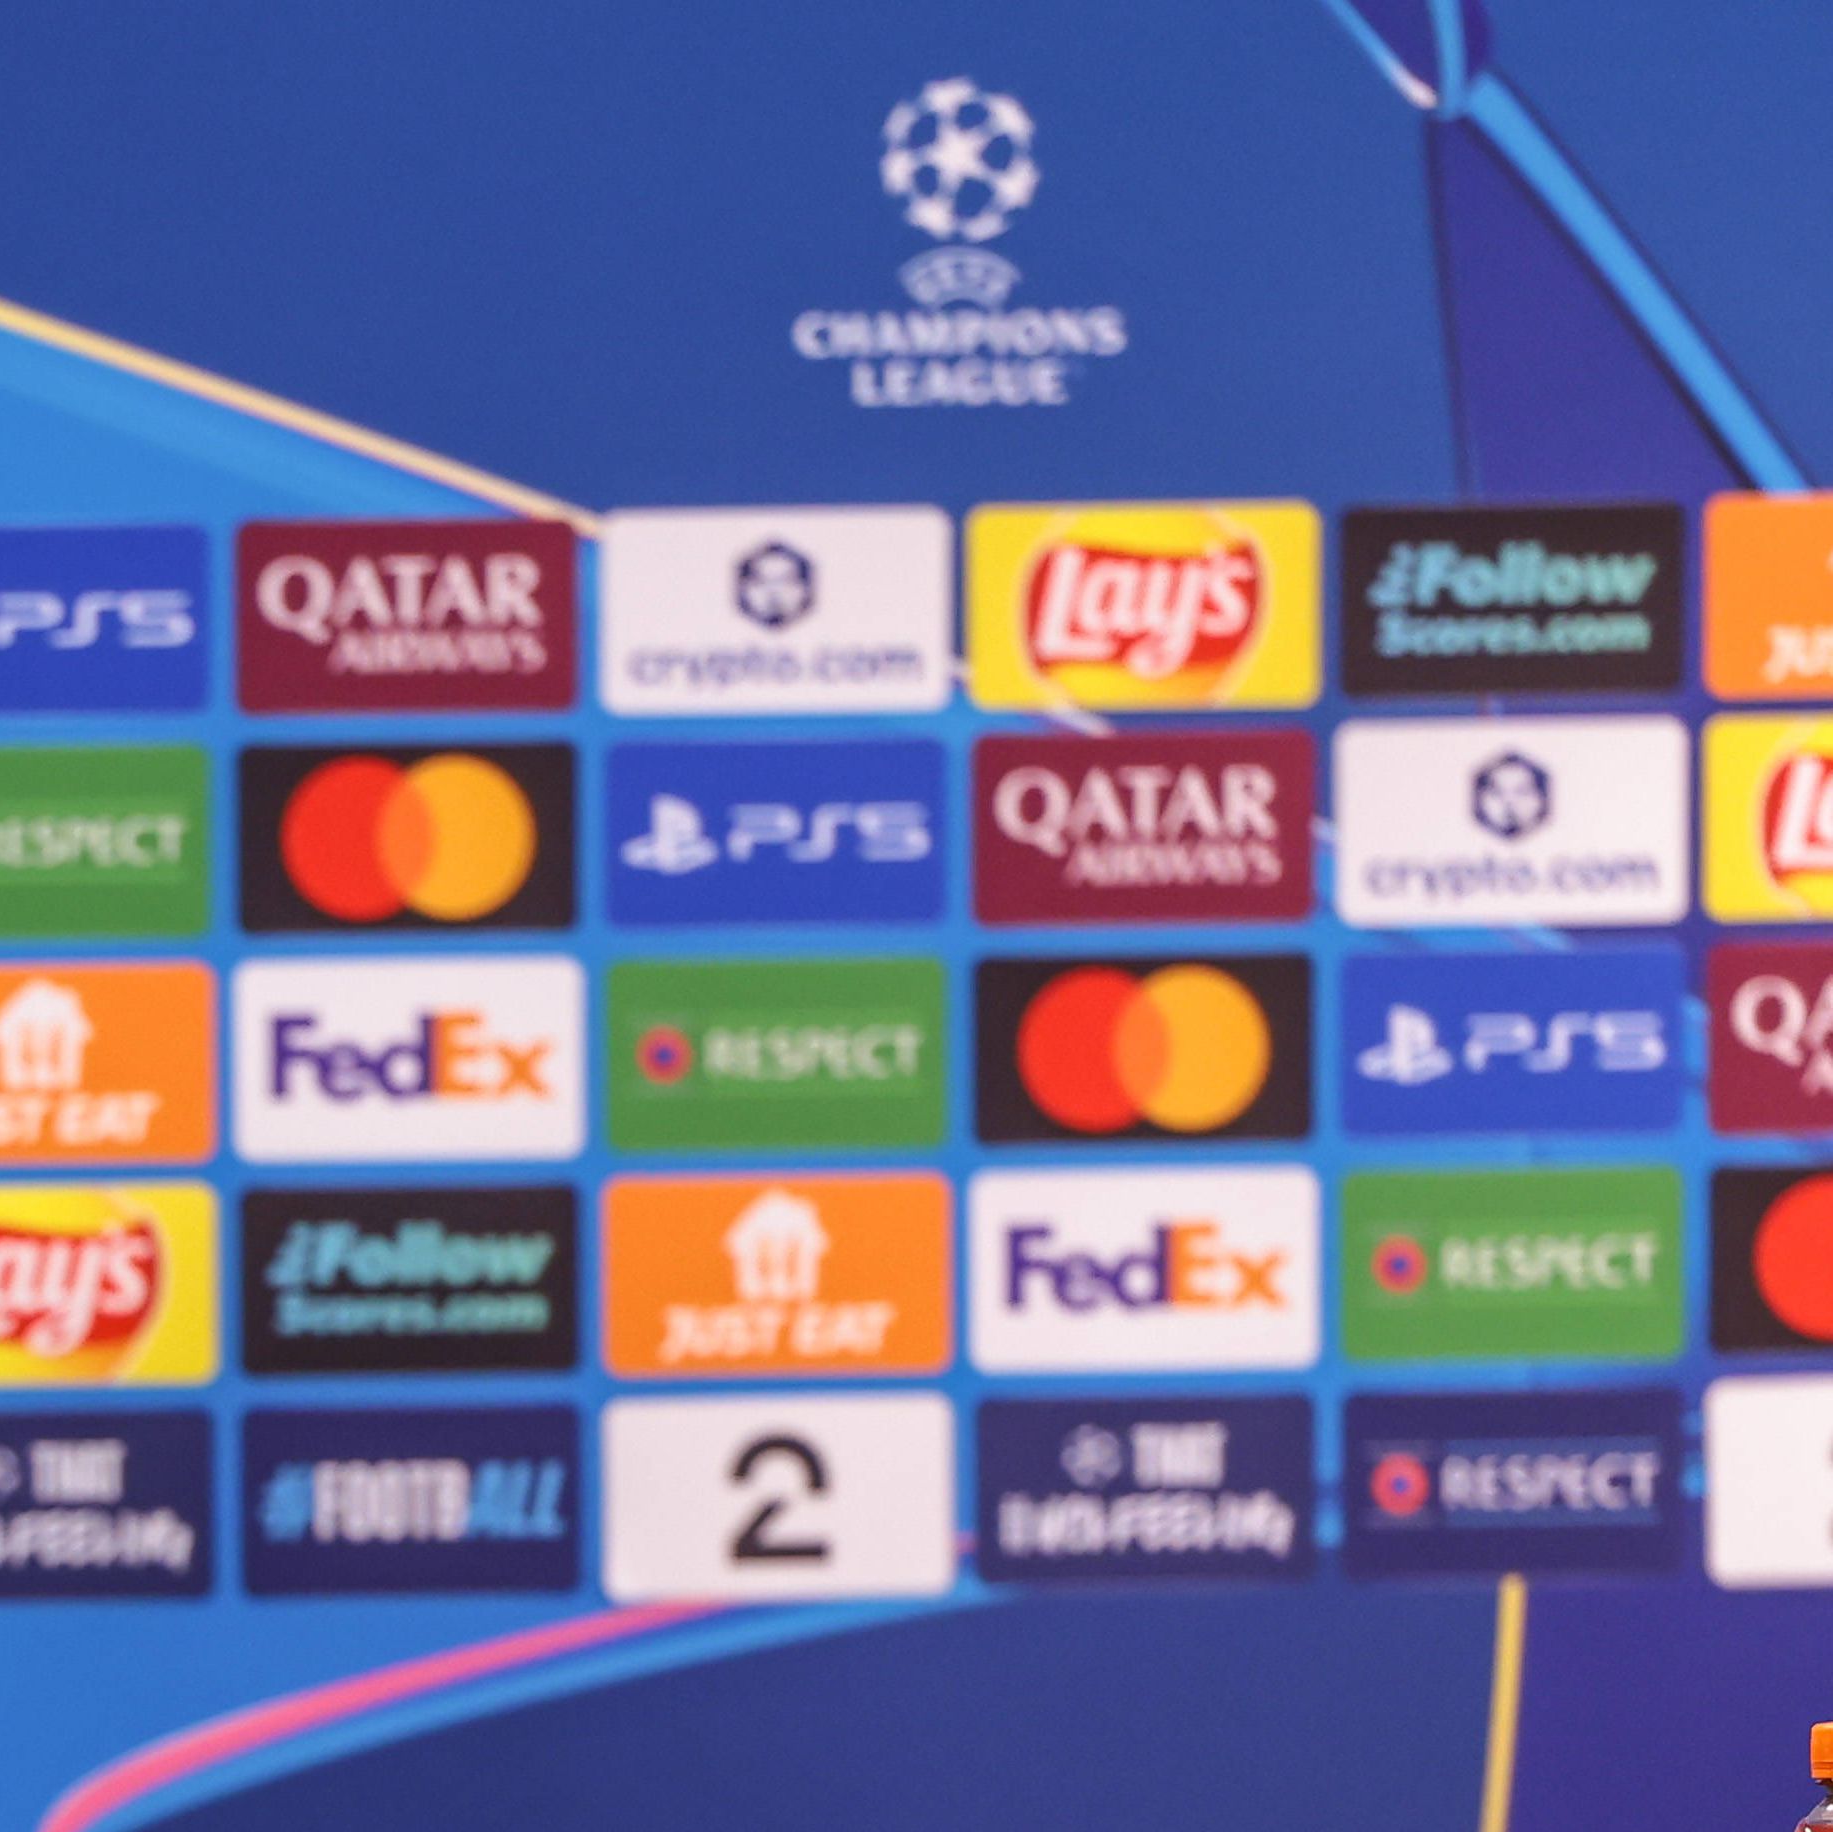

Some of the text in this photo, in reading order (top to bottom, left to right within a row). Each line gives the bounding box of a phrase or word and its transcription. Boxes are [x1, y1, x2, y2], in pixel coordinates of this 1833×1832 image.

[257, 554, 545, 644] QATAR
[1033, 543, 1252, 680] Lay's
[727, 803, 932, 862] PS5
[993, 764, 1280, 855] QATAR
[269, 1012, 552, 1102] FedEx
[1464, 1013, 1666, 1072] PS5
[54, 1092, 162, 1145] EAT
[1005, 1222, 1288, 1314] FedEx
[730, 1434, 831, 1565] 2
[1441, 1452, 1661, 1511] RESPECT
